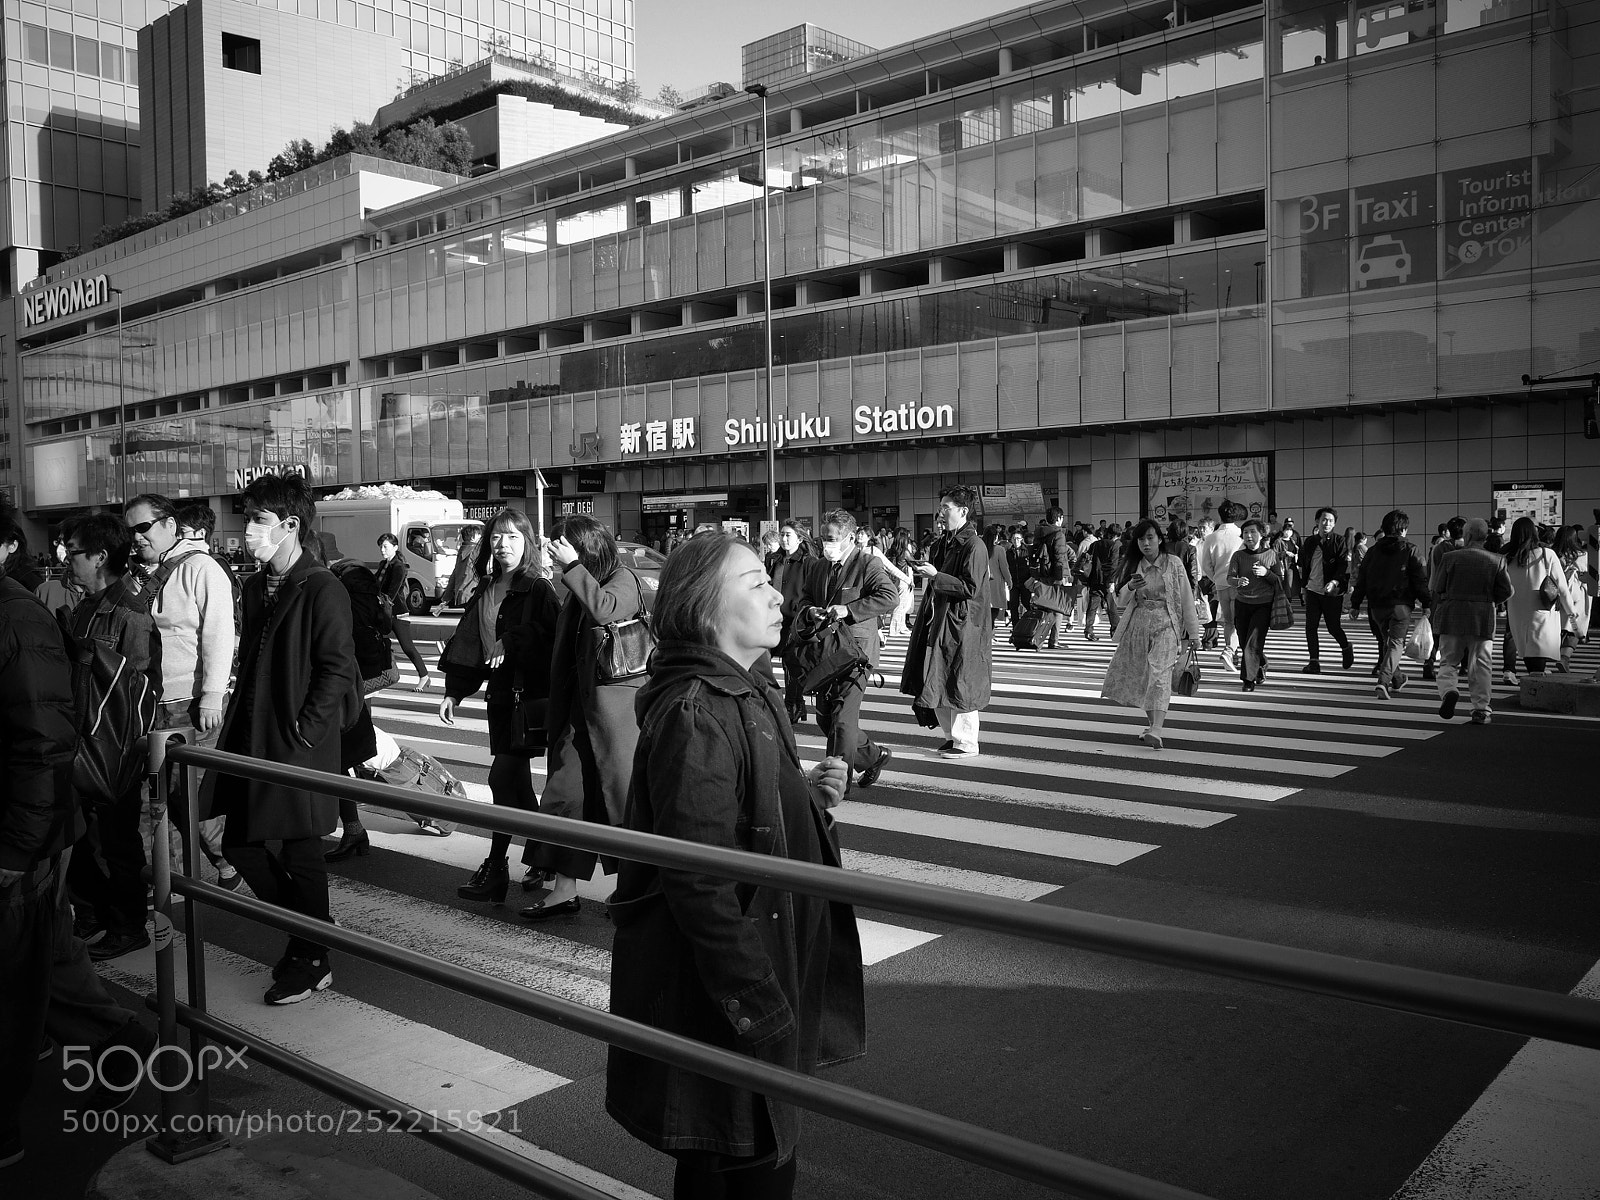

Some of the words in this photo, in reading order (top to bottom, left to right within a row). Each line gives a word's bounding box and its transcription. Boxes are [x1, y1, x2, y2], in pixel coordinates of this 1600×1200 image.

[1457, 169, 1531, 197] Tourist
[1299, 195, 1341, 234] 3F
[1355, 190, 1418, 226] Taxi
[1458, 214, 1528, 238] Center
[24, 273, 110, 327] NEWoMan
[619, 415, 696, 454] 新宿駅
[724, 412, 831, 448] Shinjuku
[854, 400, 954, 434] Station
[234, 463, 306, 490] NEWn
